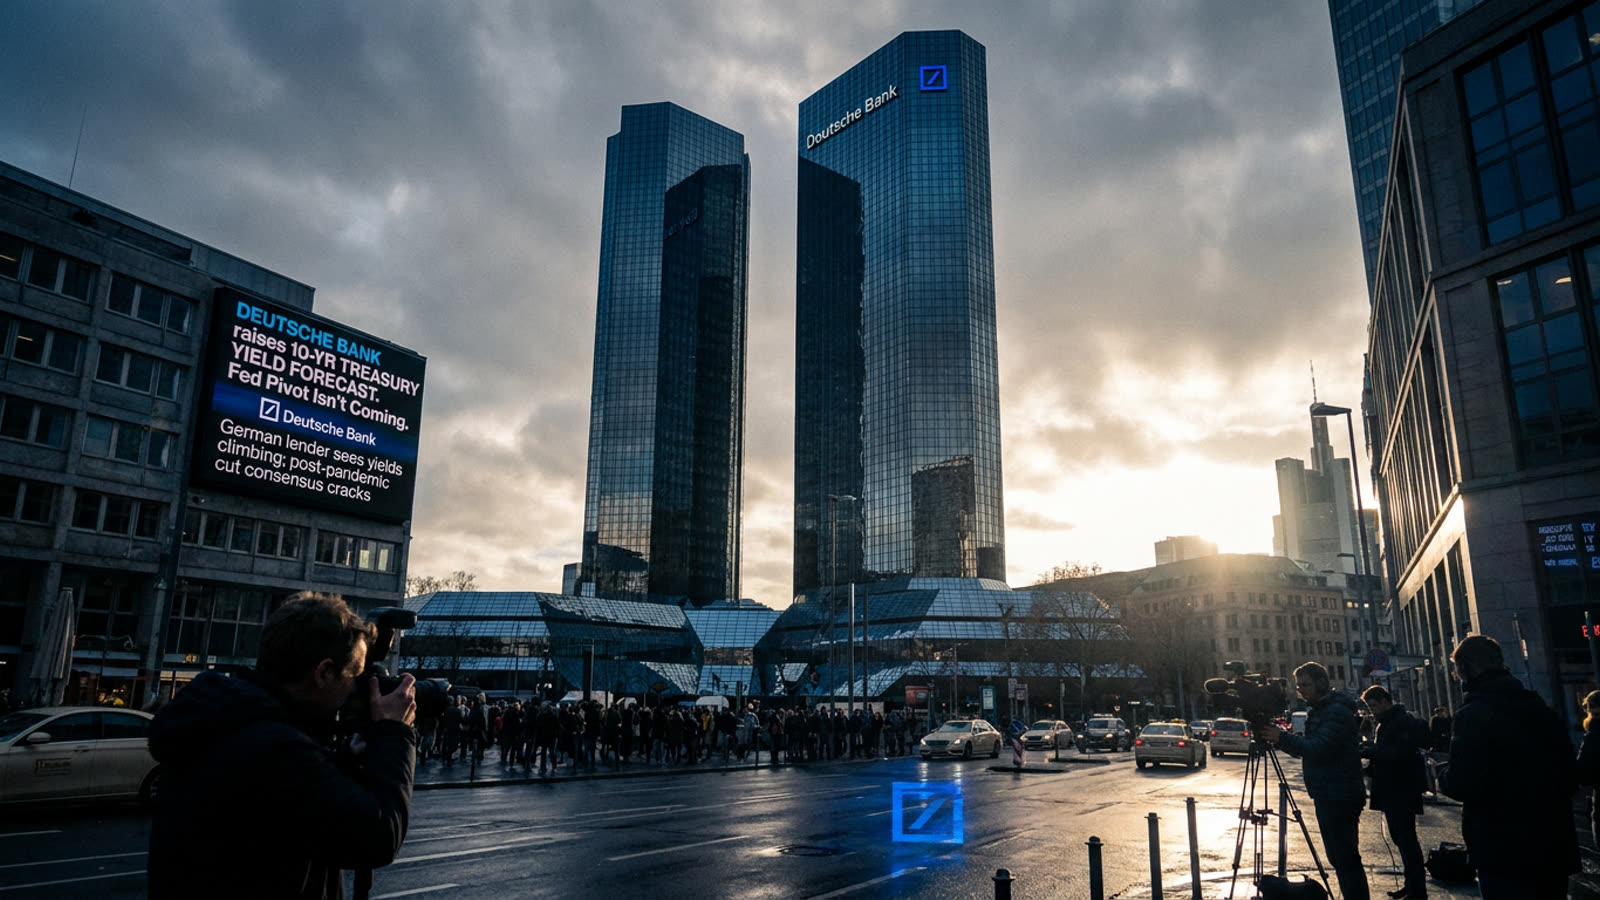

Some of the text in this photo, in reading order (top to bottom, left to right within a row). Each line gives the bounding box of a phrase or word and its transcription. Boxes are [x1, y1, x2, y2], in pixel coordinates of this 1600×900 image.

[865, 85, 898, 113] Bank
[234, 326, 419, 396] raises 10-YR TREASURY
[237, 302, 381, 365] DEUTSCHE BANK
[228, 362, 408, 431] Fed Pivot Isn't Coming.
[232, 341, 379, 402] YIELD FORECAST.
[221, 419, 402, 476] German lender sees yields
[284, 410, 375, 445] Deutsche Bank
[215, 459, 370, 501] cut consensus cracks
[290, 457, 389, 489] post-pandemic
